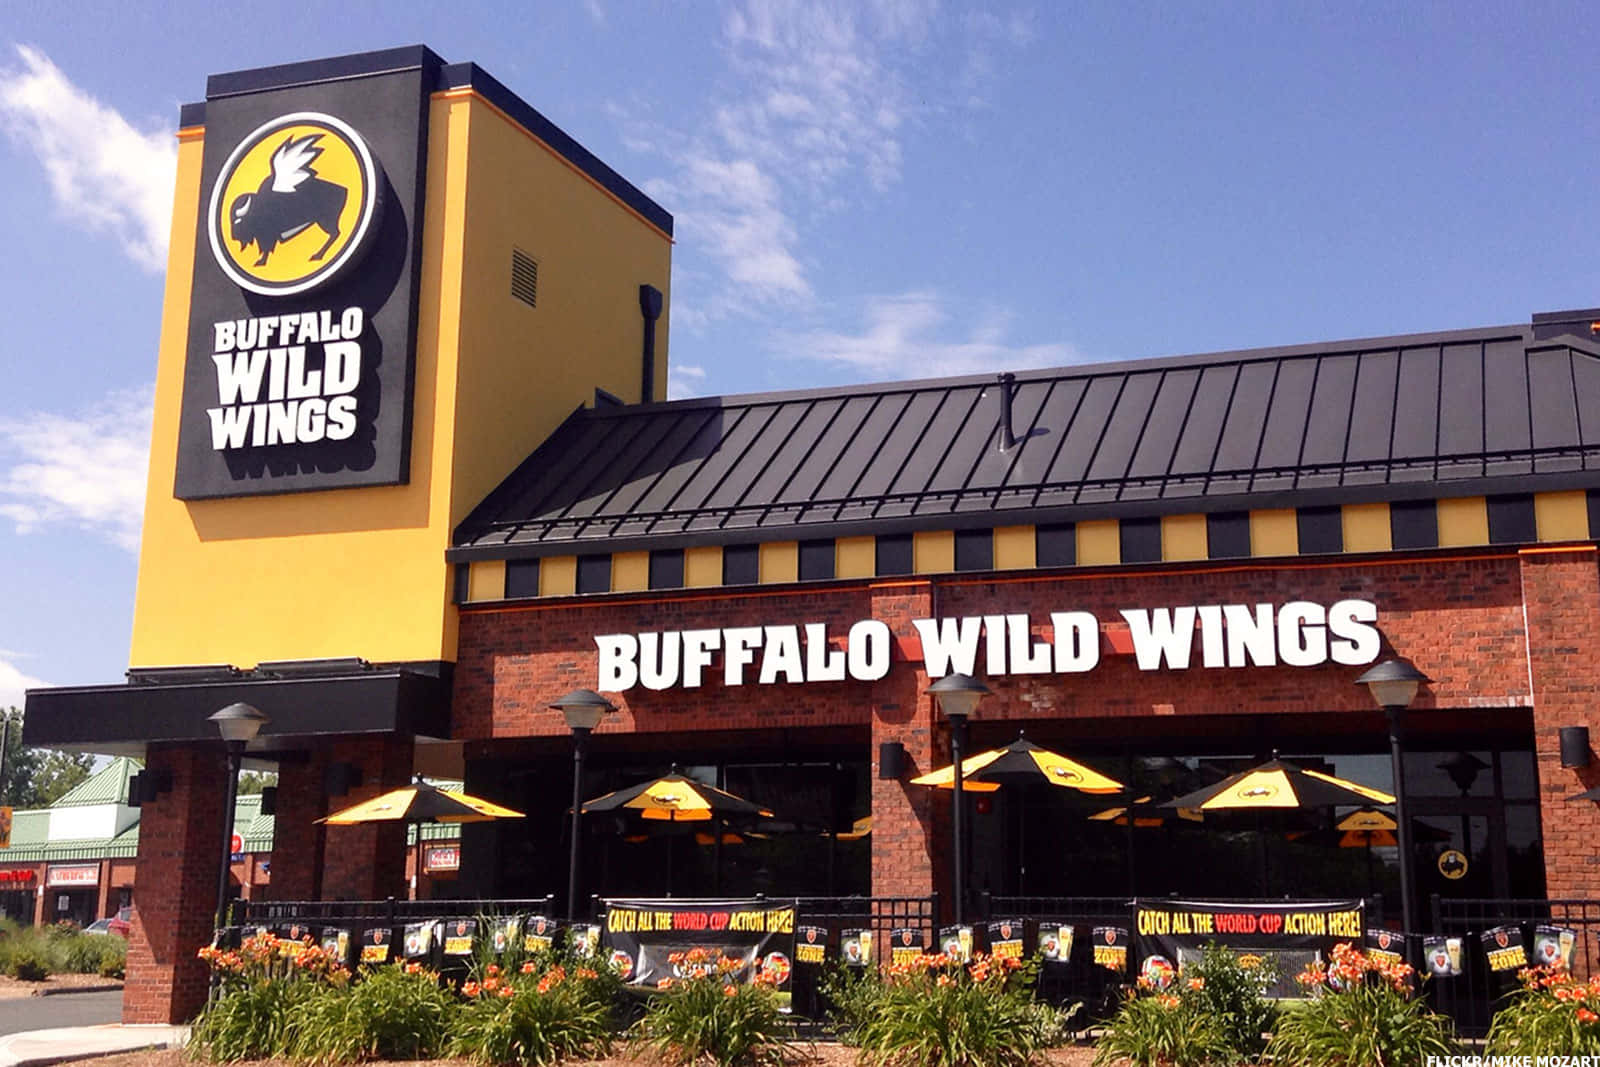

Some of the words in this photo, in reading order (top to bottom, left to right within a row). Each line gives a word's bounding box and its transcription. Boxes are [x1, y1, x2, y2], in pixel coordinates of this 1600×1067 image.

[214, 306, 363, 352] BUFFALO
[211, 341, 361, 405] WILD
[206, 395, 357, 450] WINGS
[594, 620, 891, 692] BUFFALO
[912, 611, 1099, 677] WILD
[1119, 600, 1381, 671] WINGS
[608, 909, 636, 932] CATCH
[638, 910, 652, 931] ALL
[654, 911, 672, 930] THE
[673, 912, 708, 930] WORLD
[709, 912, 729, 930] CUP
[729, 910, 765, 932] ACTION
[1138, 910, 1170, 935] CATCH
[1172, 912, 1191, 934] ALL
[1193, 913, 1213, 933] THE
[1214, 914, 1256, 934] WORLD
[1259, 914, 1282, 934] CUP
[1284, 912, 1326, 935] ACTION
[1328, 911, 1361, 937] HERE!
[1488, 950, 1527, 971] ZONE
